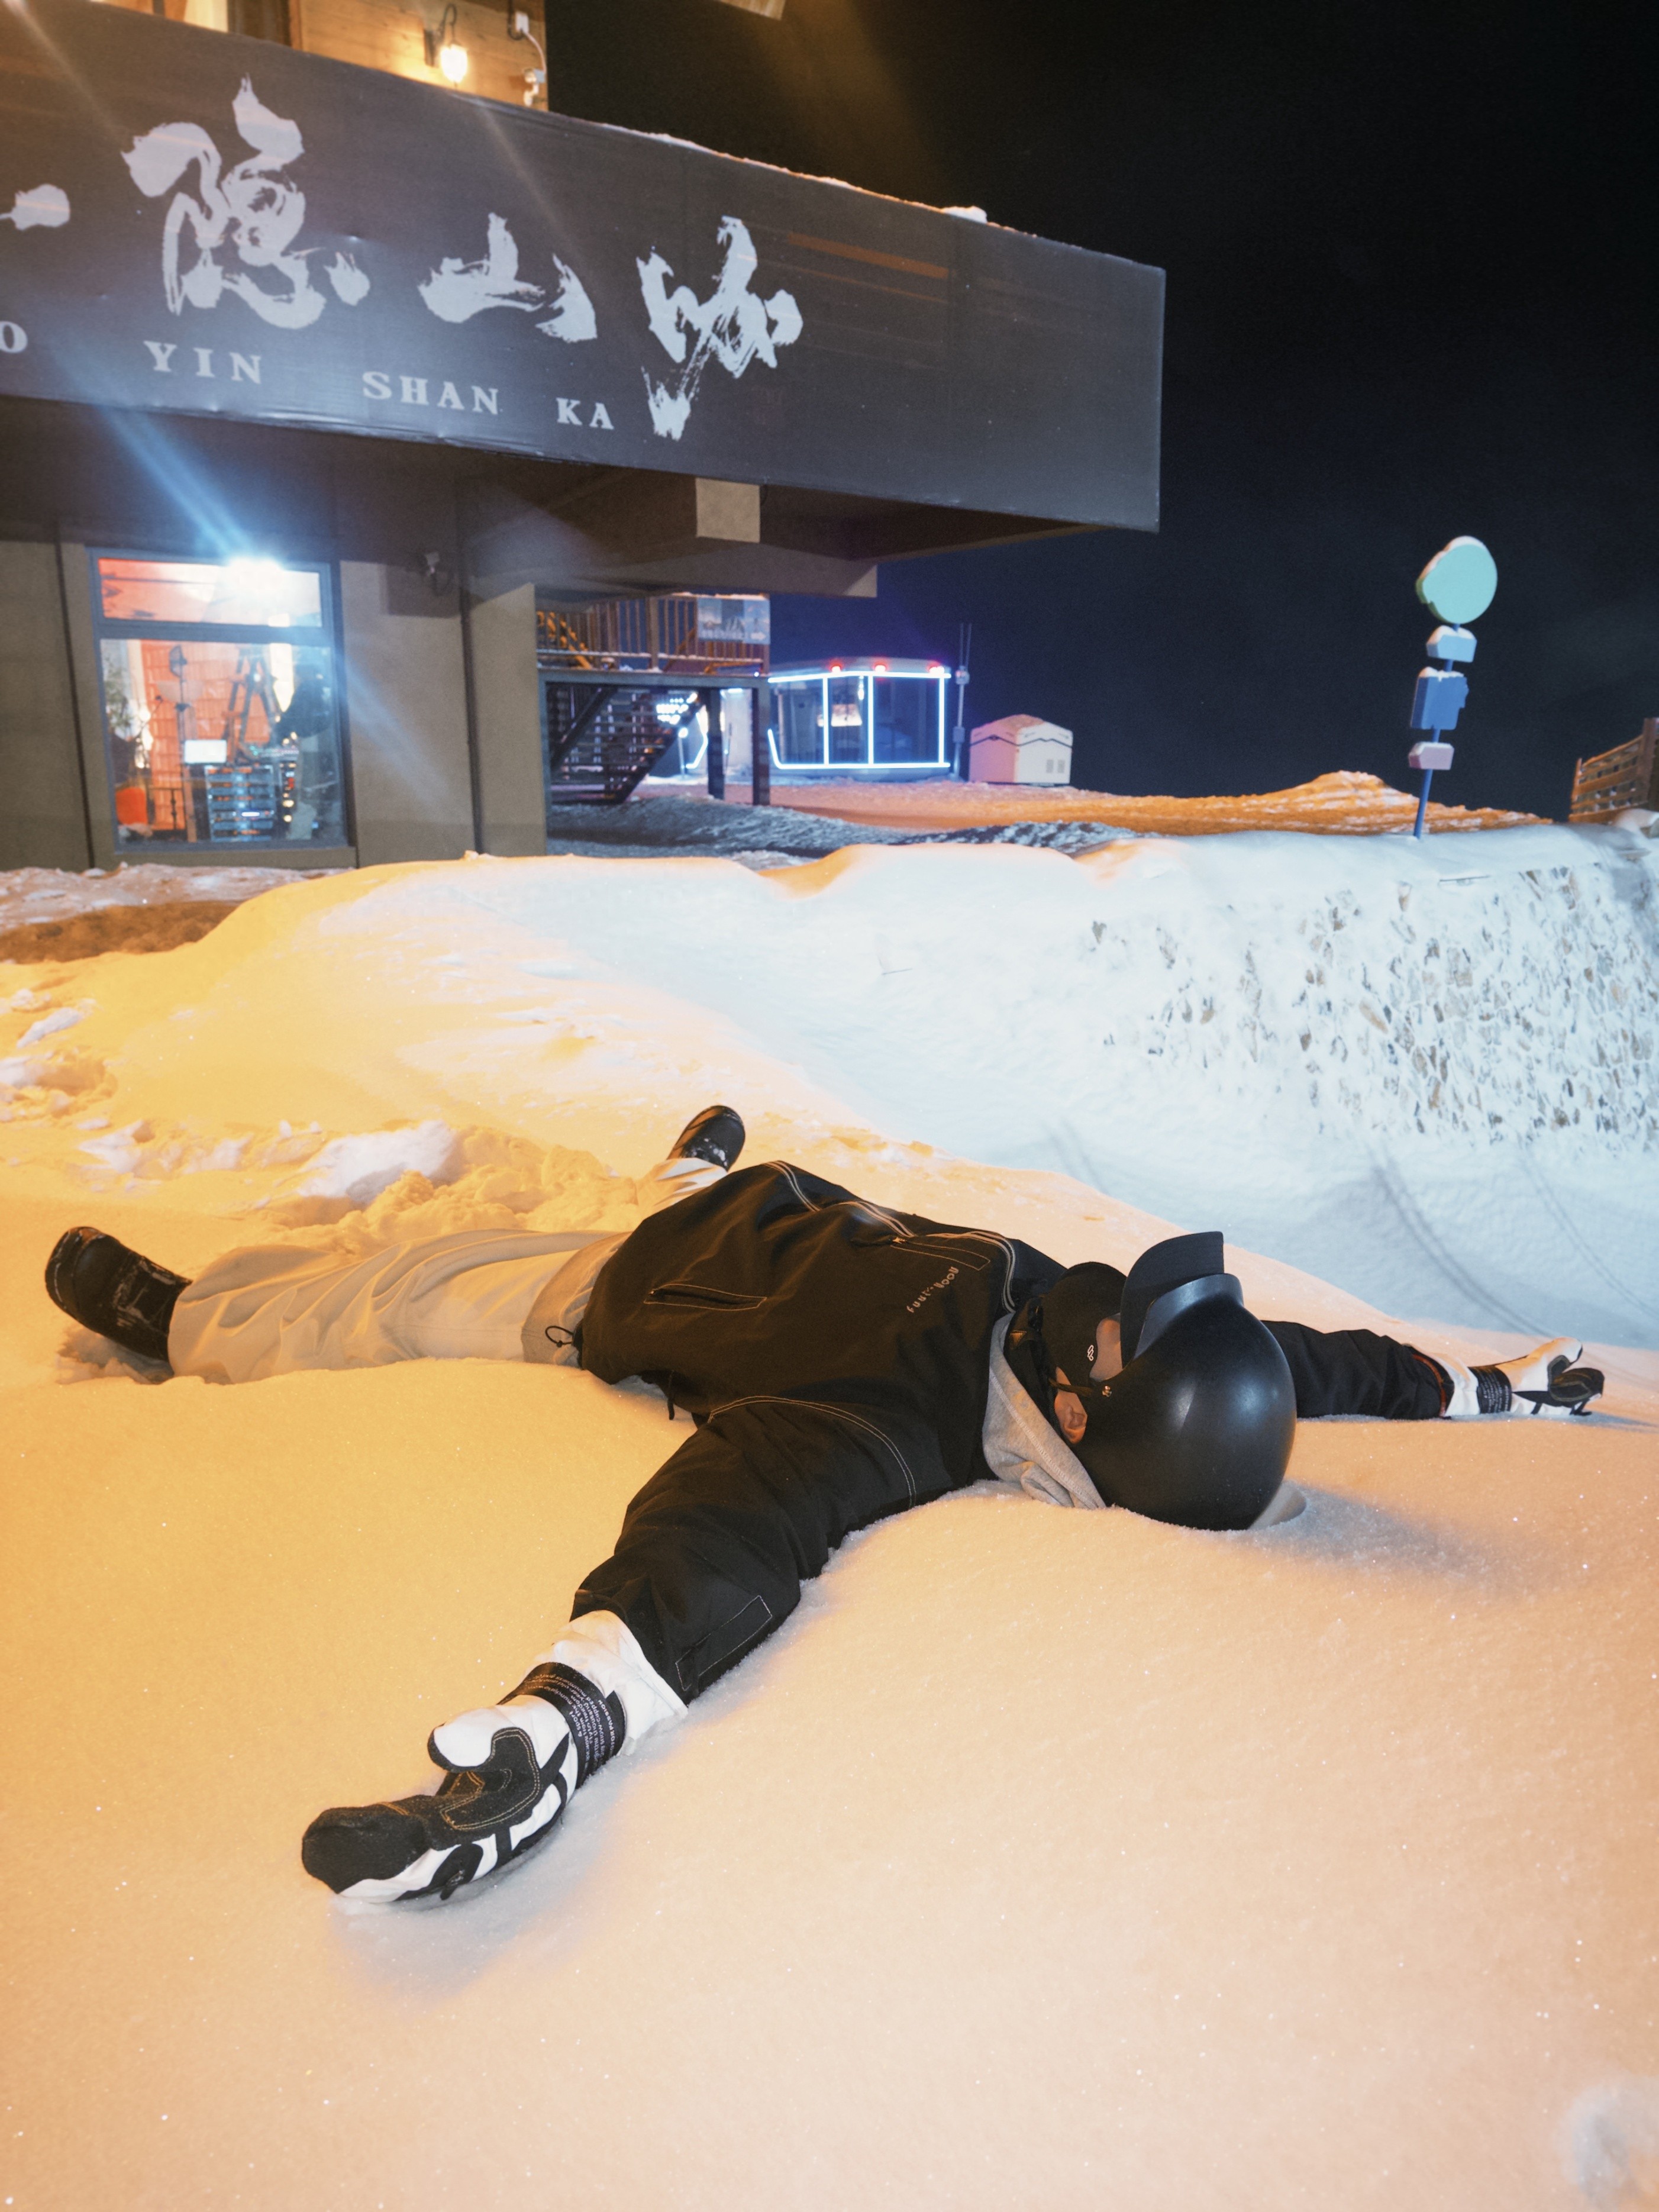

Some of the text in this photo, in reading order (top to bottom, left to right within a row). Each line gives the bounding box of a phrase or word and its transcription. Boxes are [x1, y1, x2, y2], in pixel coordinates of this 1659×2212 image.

[144, 340, 263, 385] YIN
[363, 370, 500, 417] SHAN
[556, 397, 615, 431] KA
